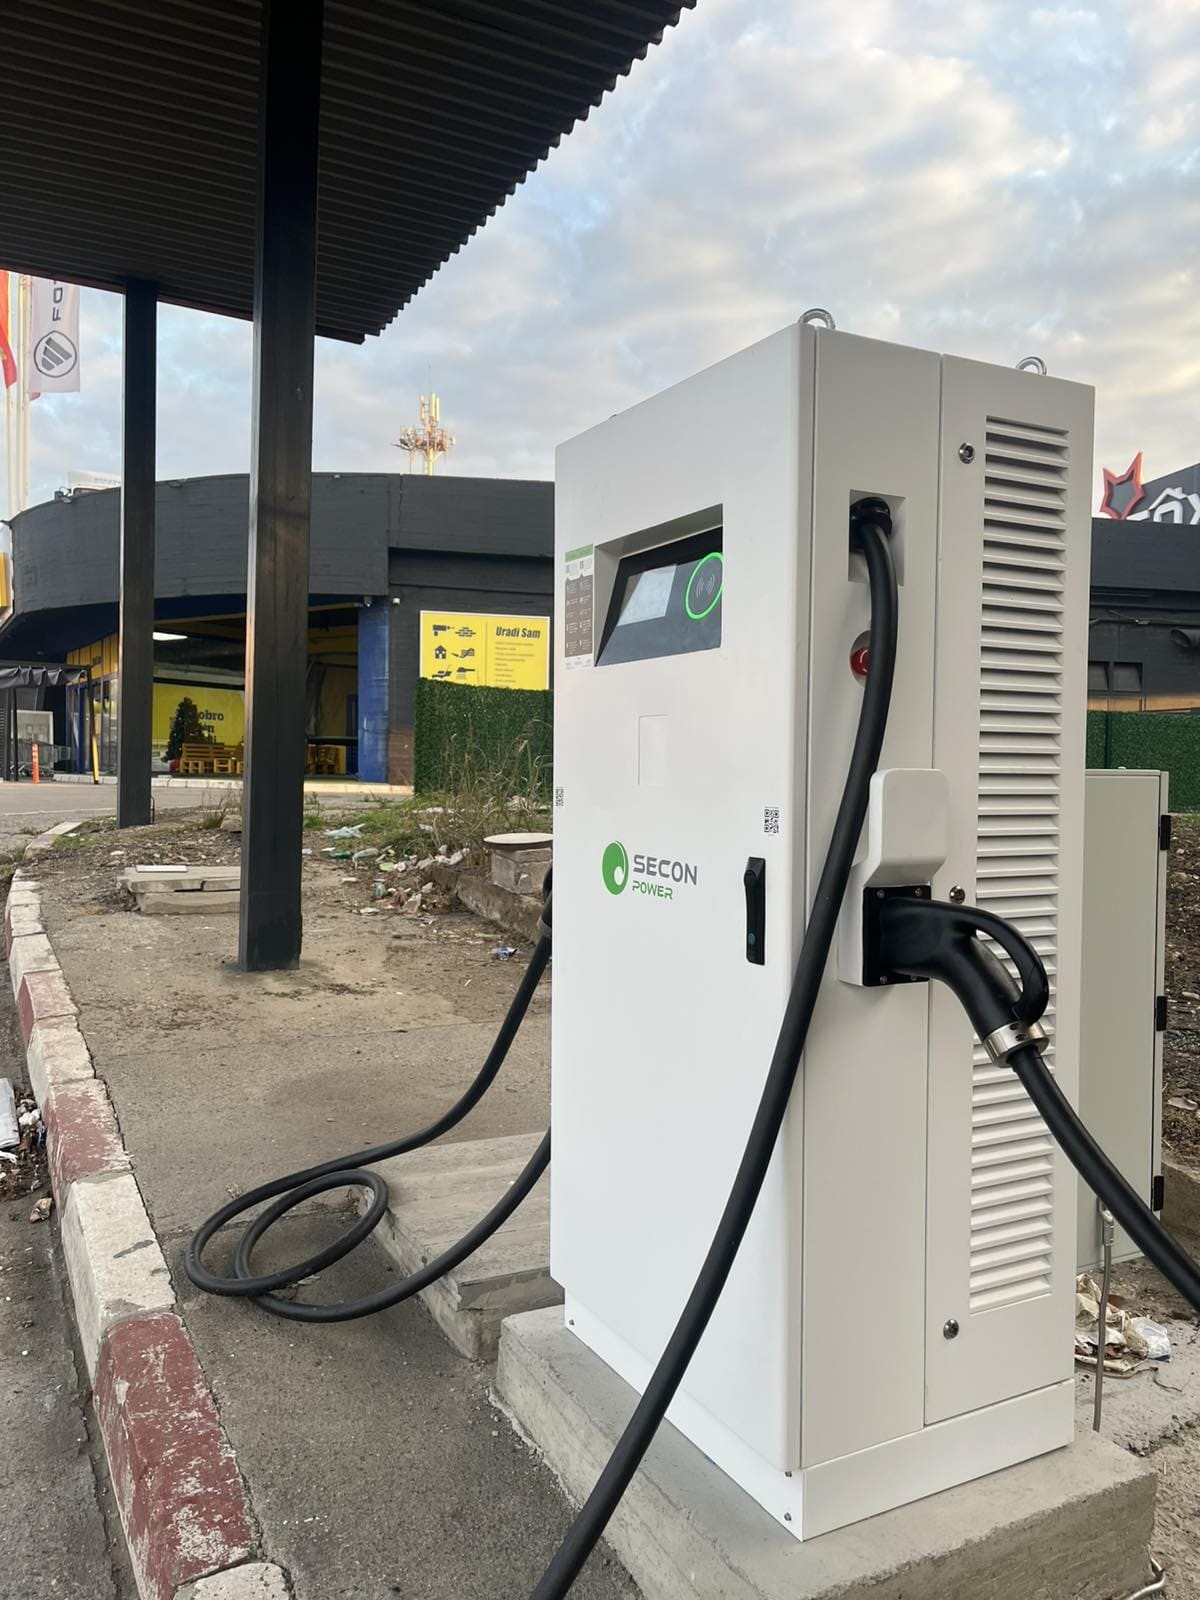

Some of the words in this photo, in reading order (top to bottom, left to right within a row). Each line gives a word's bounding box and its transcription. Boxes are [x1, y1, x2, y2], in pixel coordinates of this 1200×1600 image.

[496, 626, 520, 637] Uradi
[521, 628, 541, 638] Sam
[198, 709, 224, 721] obro
[633, 854, 698, 886] SECON
[632, 881, 674, 900] POWER
